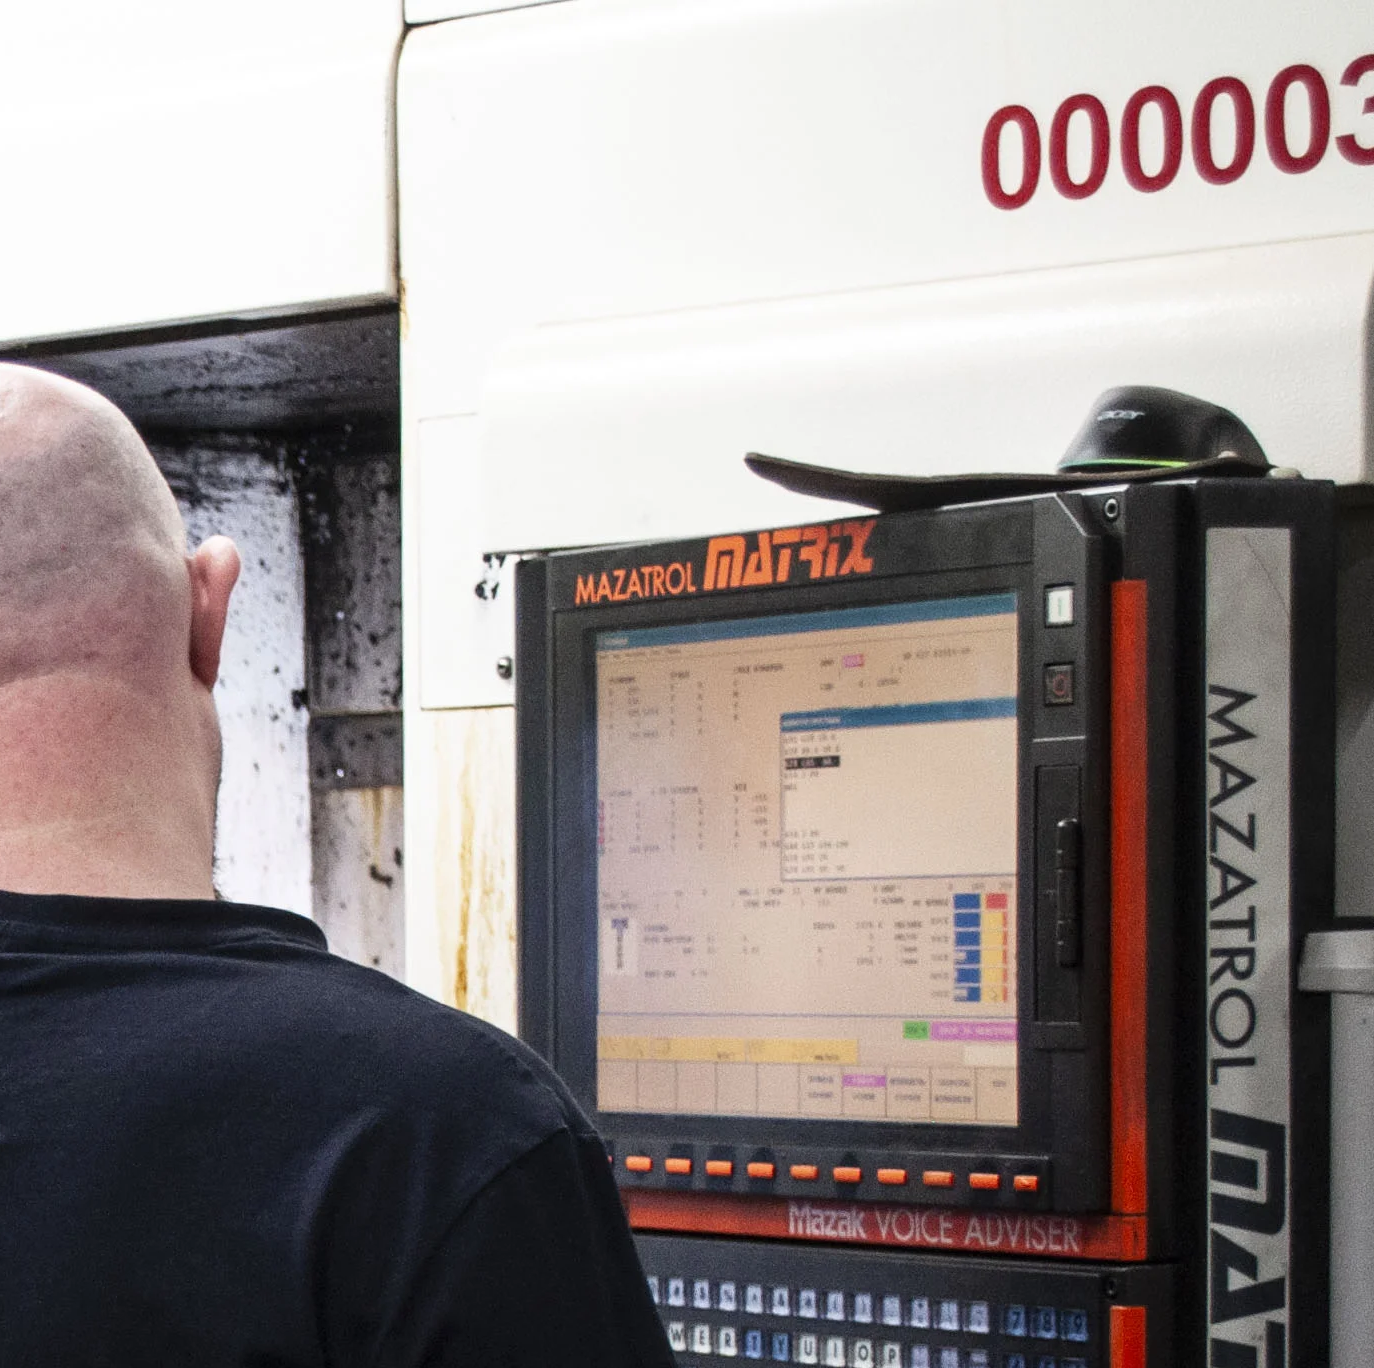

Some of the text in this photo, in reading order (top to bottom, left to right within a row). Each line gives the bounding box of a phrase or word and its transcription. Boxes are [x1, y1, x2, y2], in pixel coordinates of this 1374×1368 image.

[980, 53, 1374, 211] 000003
[1096, 409, 1145, 421] acer
[574, 561, 696, 606] MAZATROL
[1206, 683, 1258, 1086] MAZATROL
[788, 1202, 1080, 1252] Mazak VOICE ADVISER
